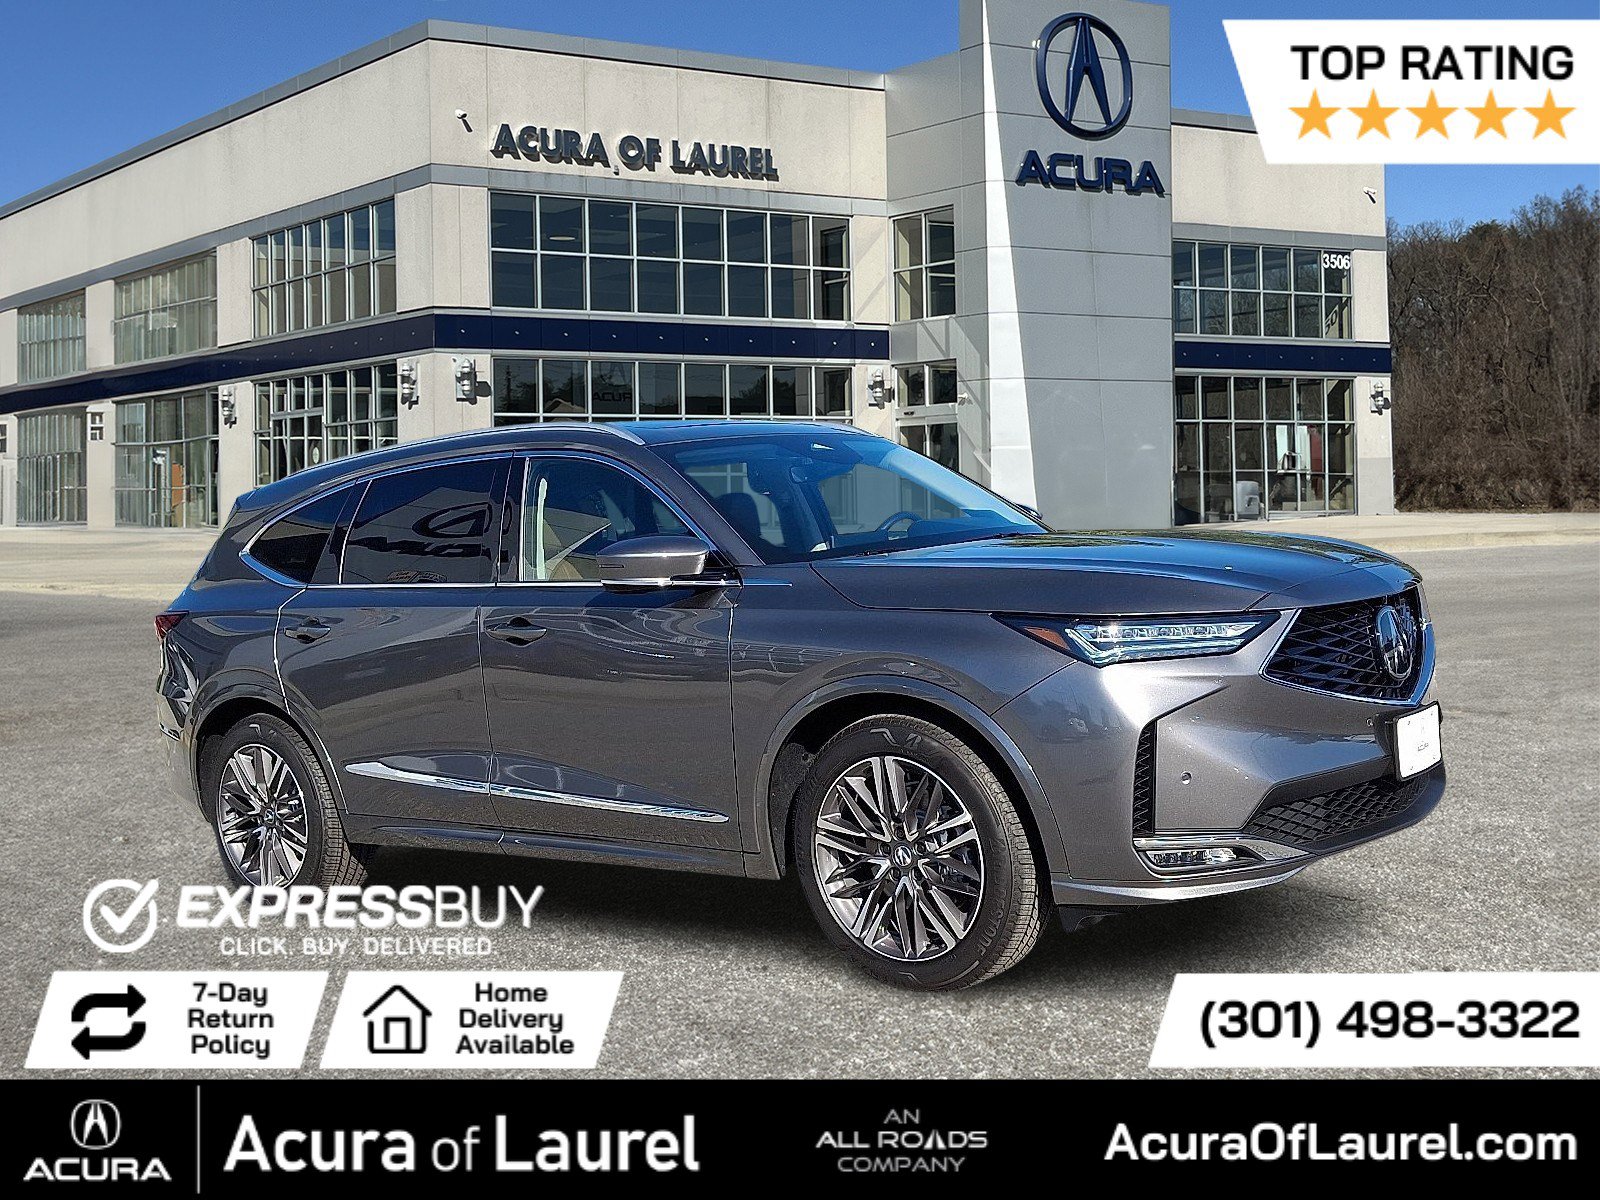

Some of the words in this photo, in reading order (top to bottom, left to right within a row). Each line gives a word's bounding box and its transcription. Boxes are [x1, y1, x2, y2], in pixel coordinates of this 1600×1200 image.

[490, 123, 611, 168] ACURA
[616, 134, 662, 172] OF
[670, 140, 779, 182] LAUREL
[1015, 150, 1165, 198] ACURA
[1322, 253, 1351, 270] 3506
